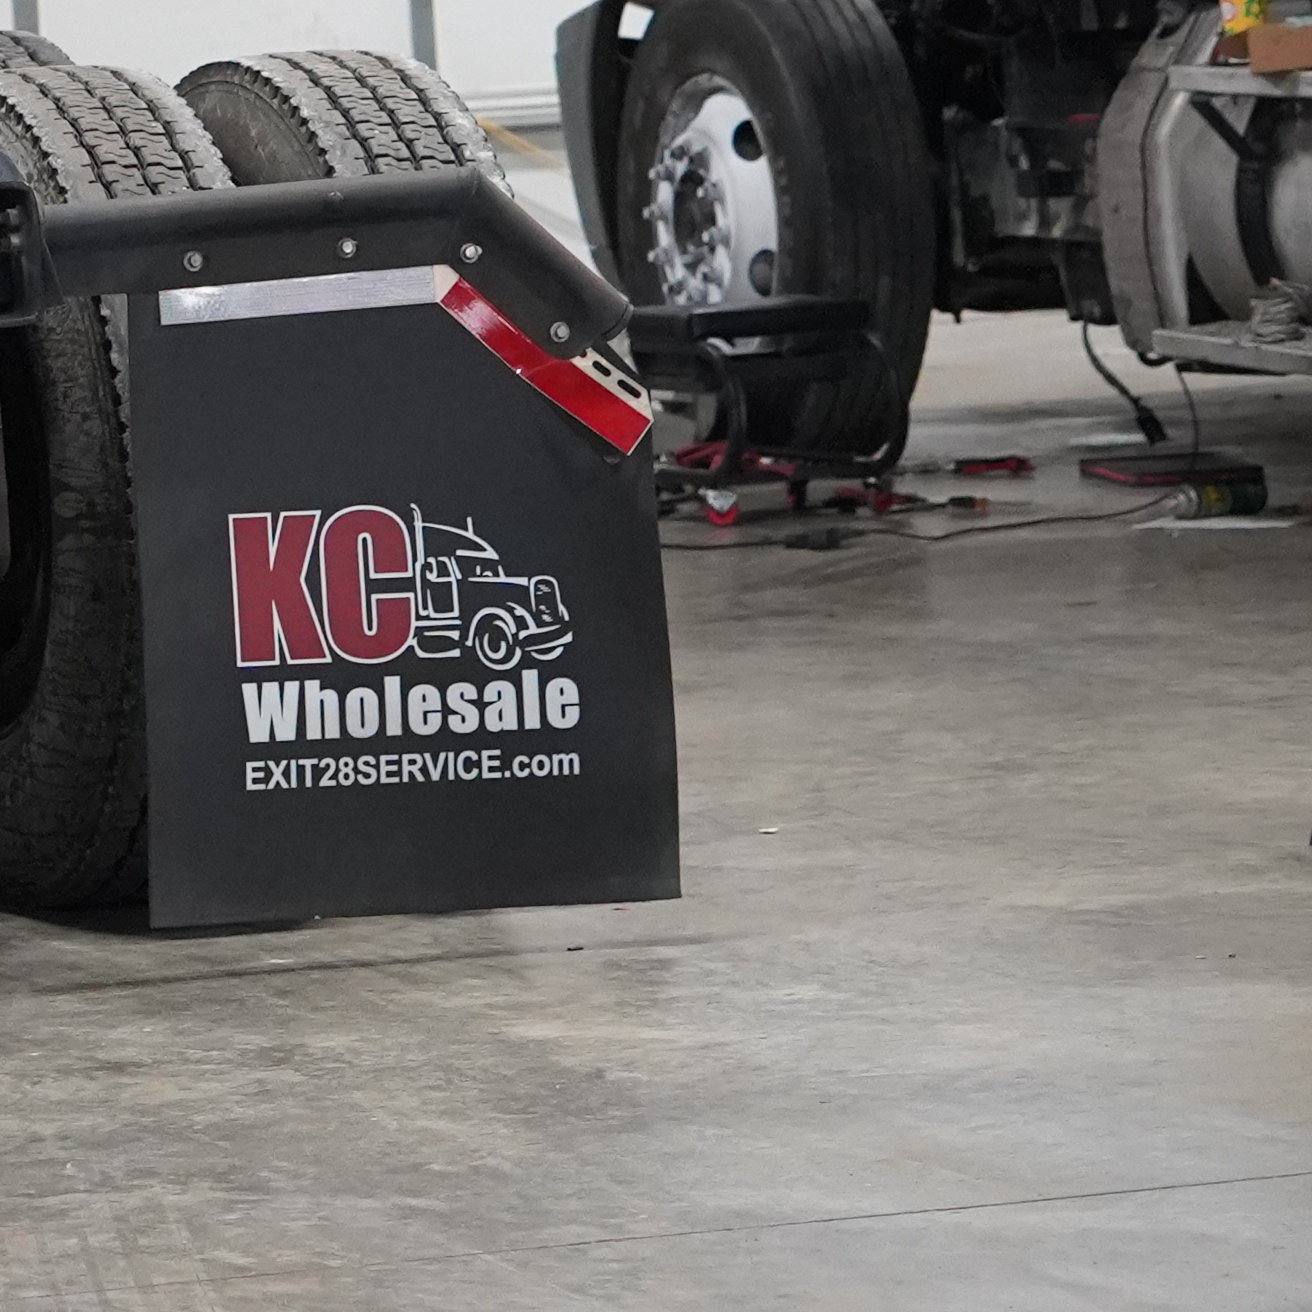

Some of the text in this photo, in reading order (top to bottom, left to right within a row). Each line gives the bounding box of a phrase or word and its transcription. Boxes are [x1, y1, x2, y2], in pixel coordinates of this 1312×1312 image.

[228, 505, 415, 668] KC
[241, 669, 581, 744] Wholesale
[245, 749, 580, 791] EXIT28SERVICE.com
